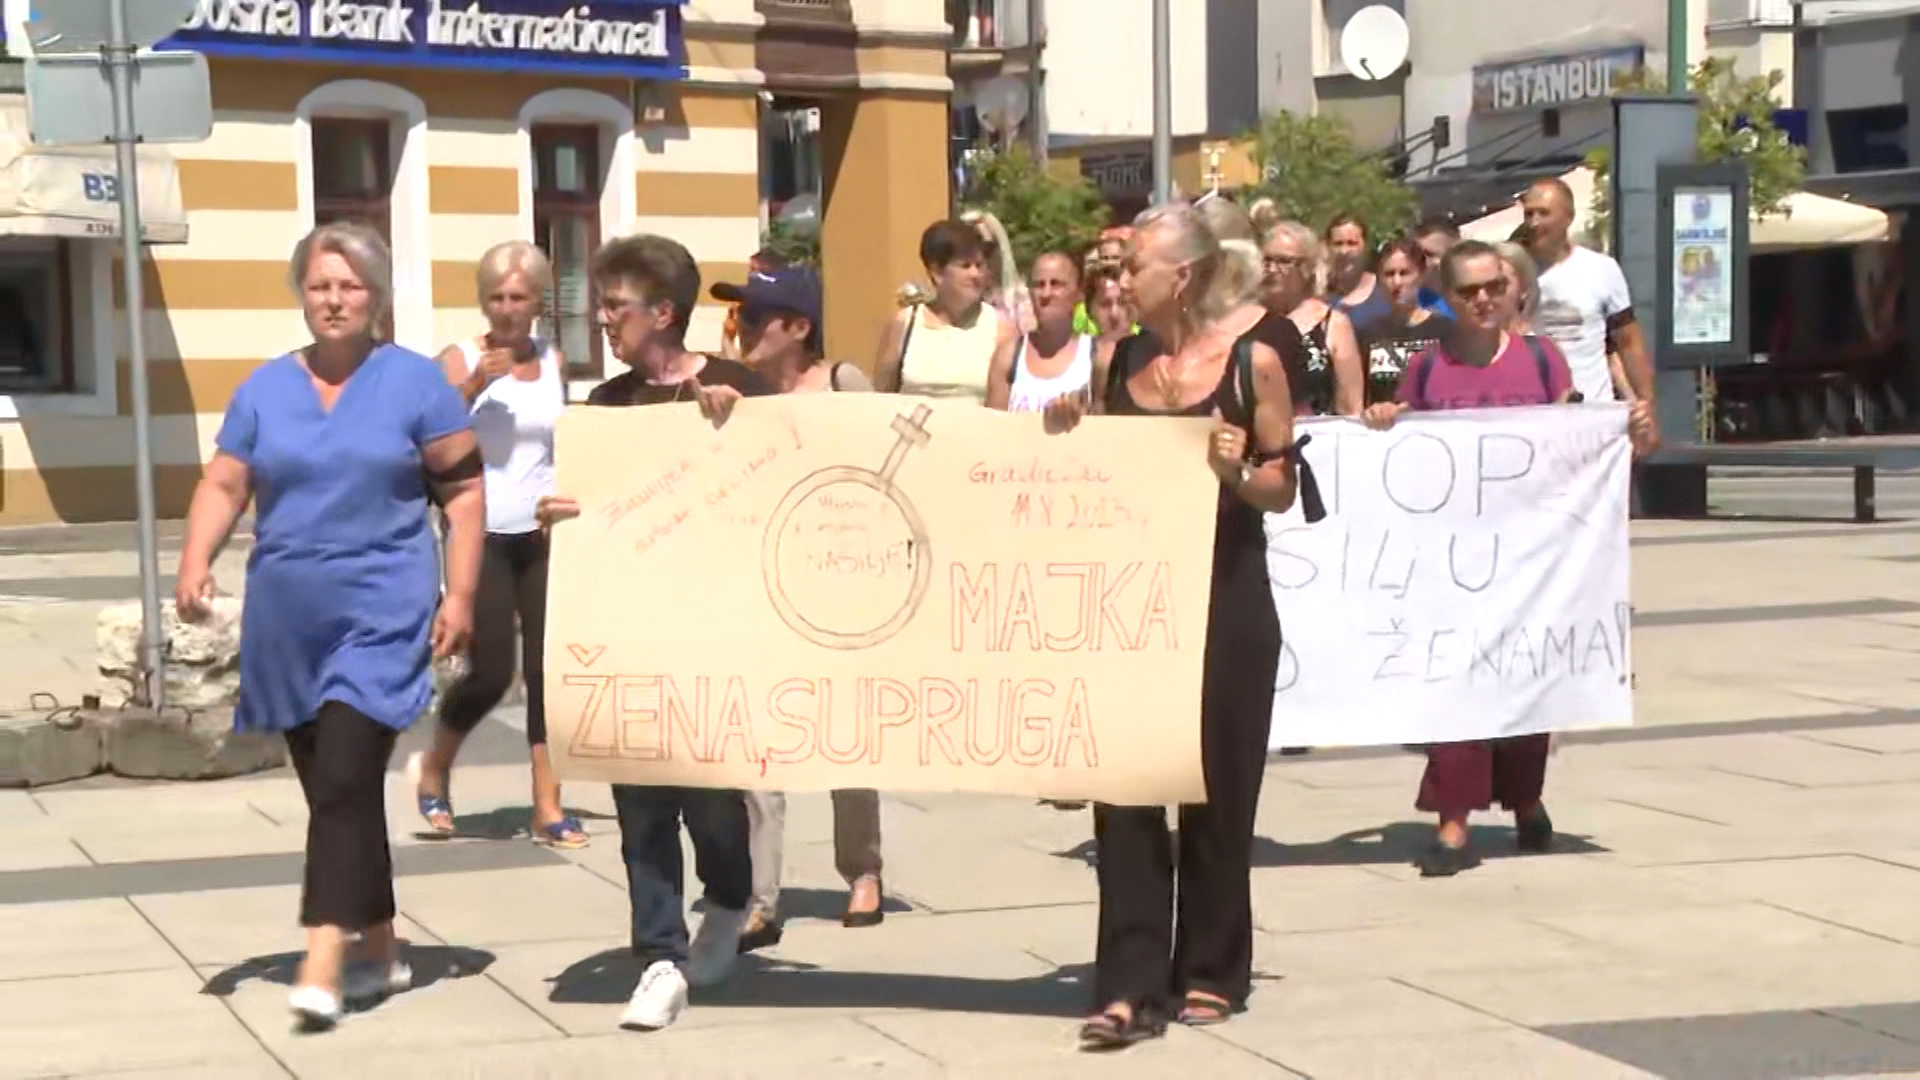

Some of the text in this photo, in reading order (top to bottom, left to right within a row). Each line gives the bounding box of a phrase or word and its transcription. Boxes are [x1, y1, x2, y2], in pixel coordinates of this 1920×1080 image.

[309, 0, 415, 43] Bank
[427, 0, 669, 57] International
[1493, 57, 1615, 109] ISTANBUL
[950, 561, 1179, 652] MAJKA
